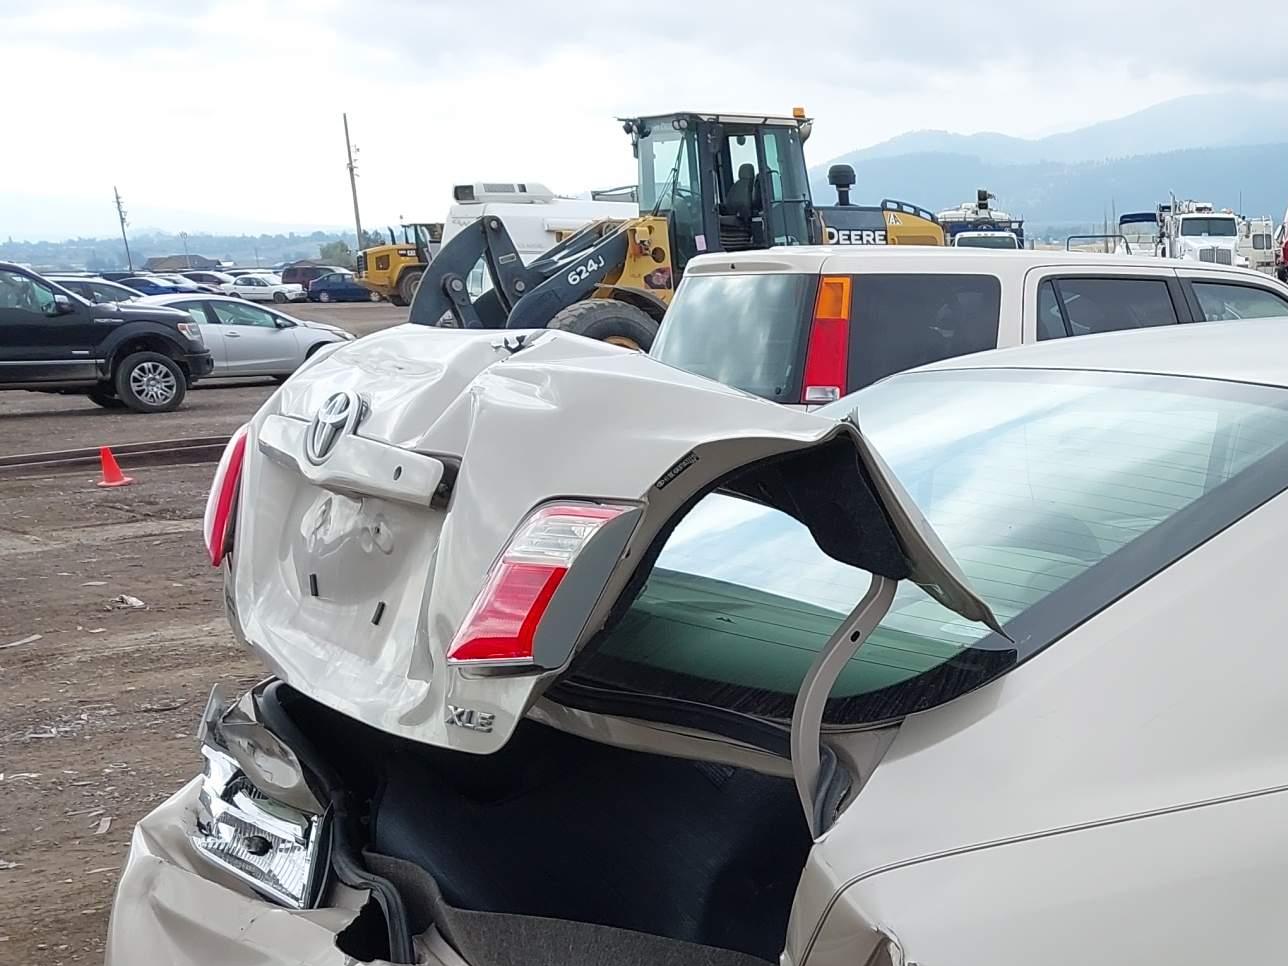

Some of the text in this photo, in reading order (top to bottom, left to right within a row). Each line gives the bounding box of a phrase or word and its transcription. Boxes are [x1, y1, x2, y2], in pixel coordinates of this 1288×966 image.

[826, 227, 886, 245] DEERE
[567, 255, 605, 285] 624J
[444, 704, 496, 733] XLE
